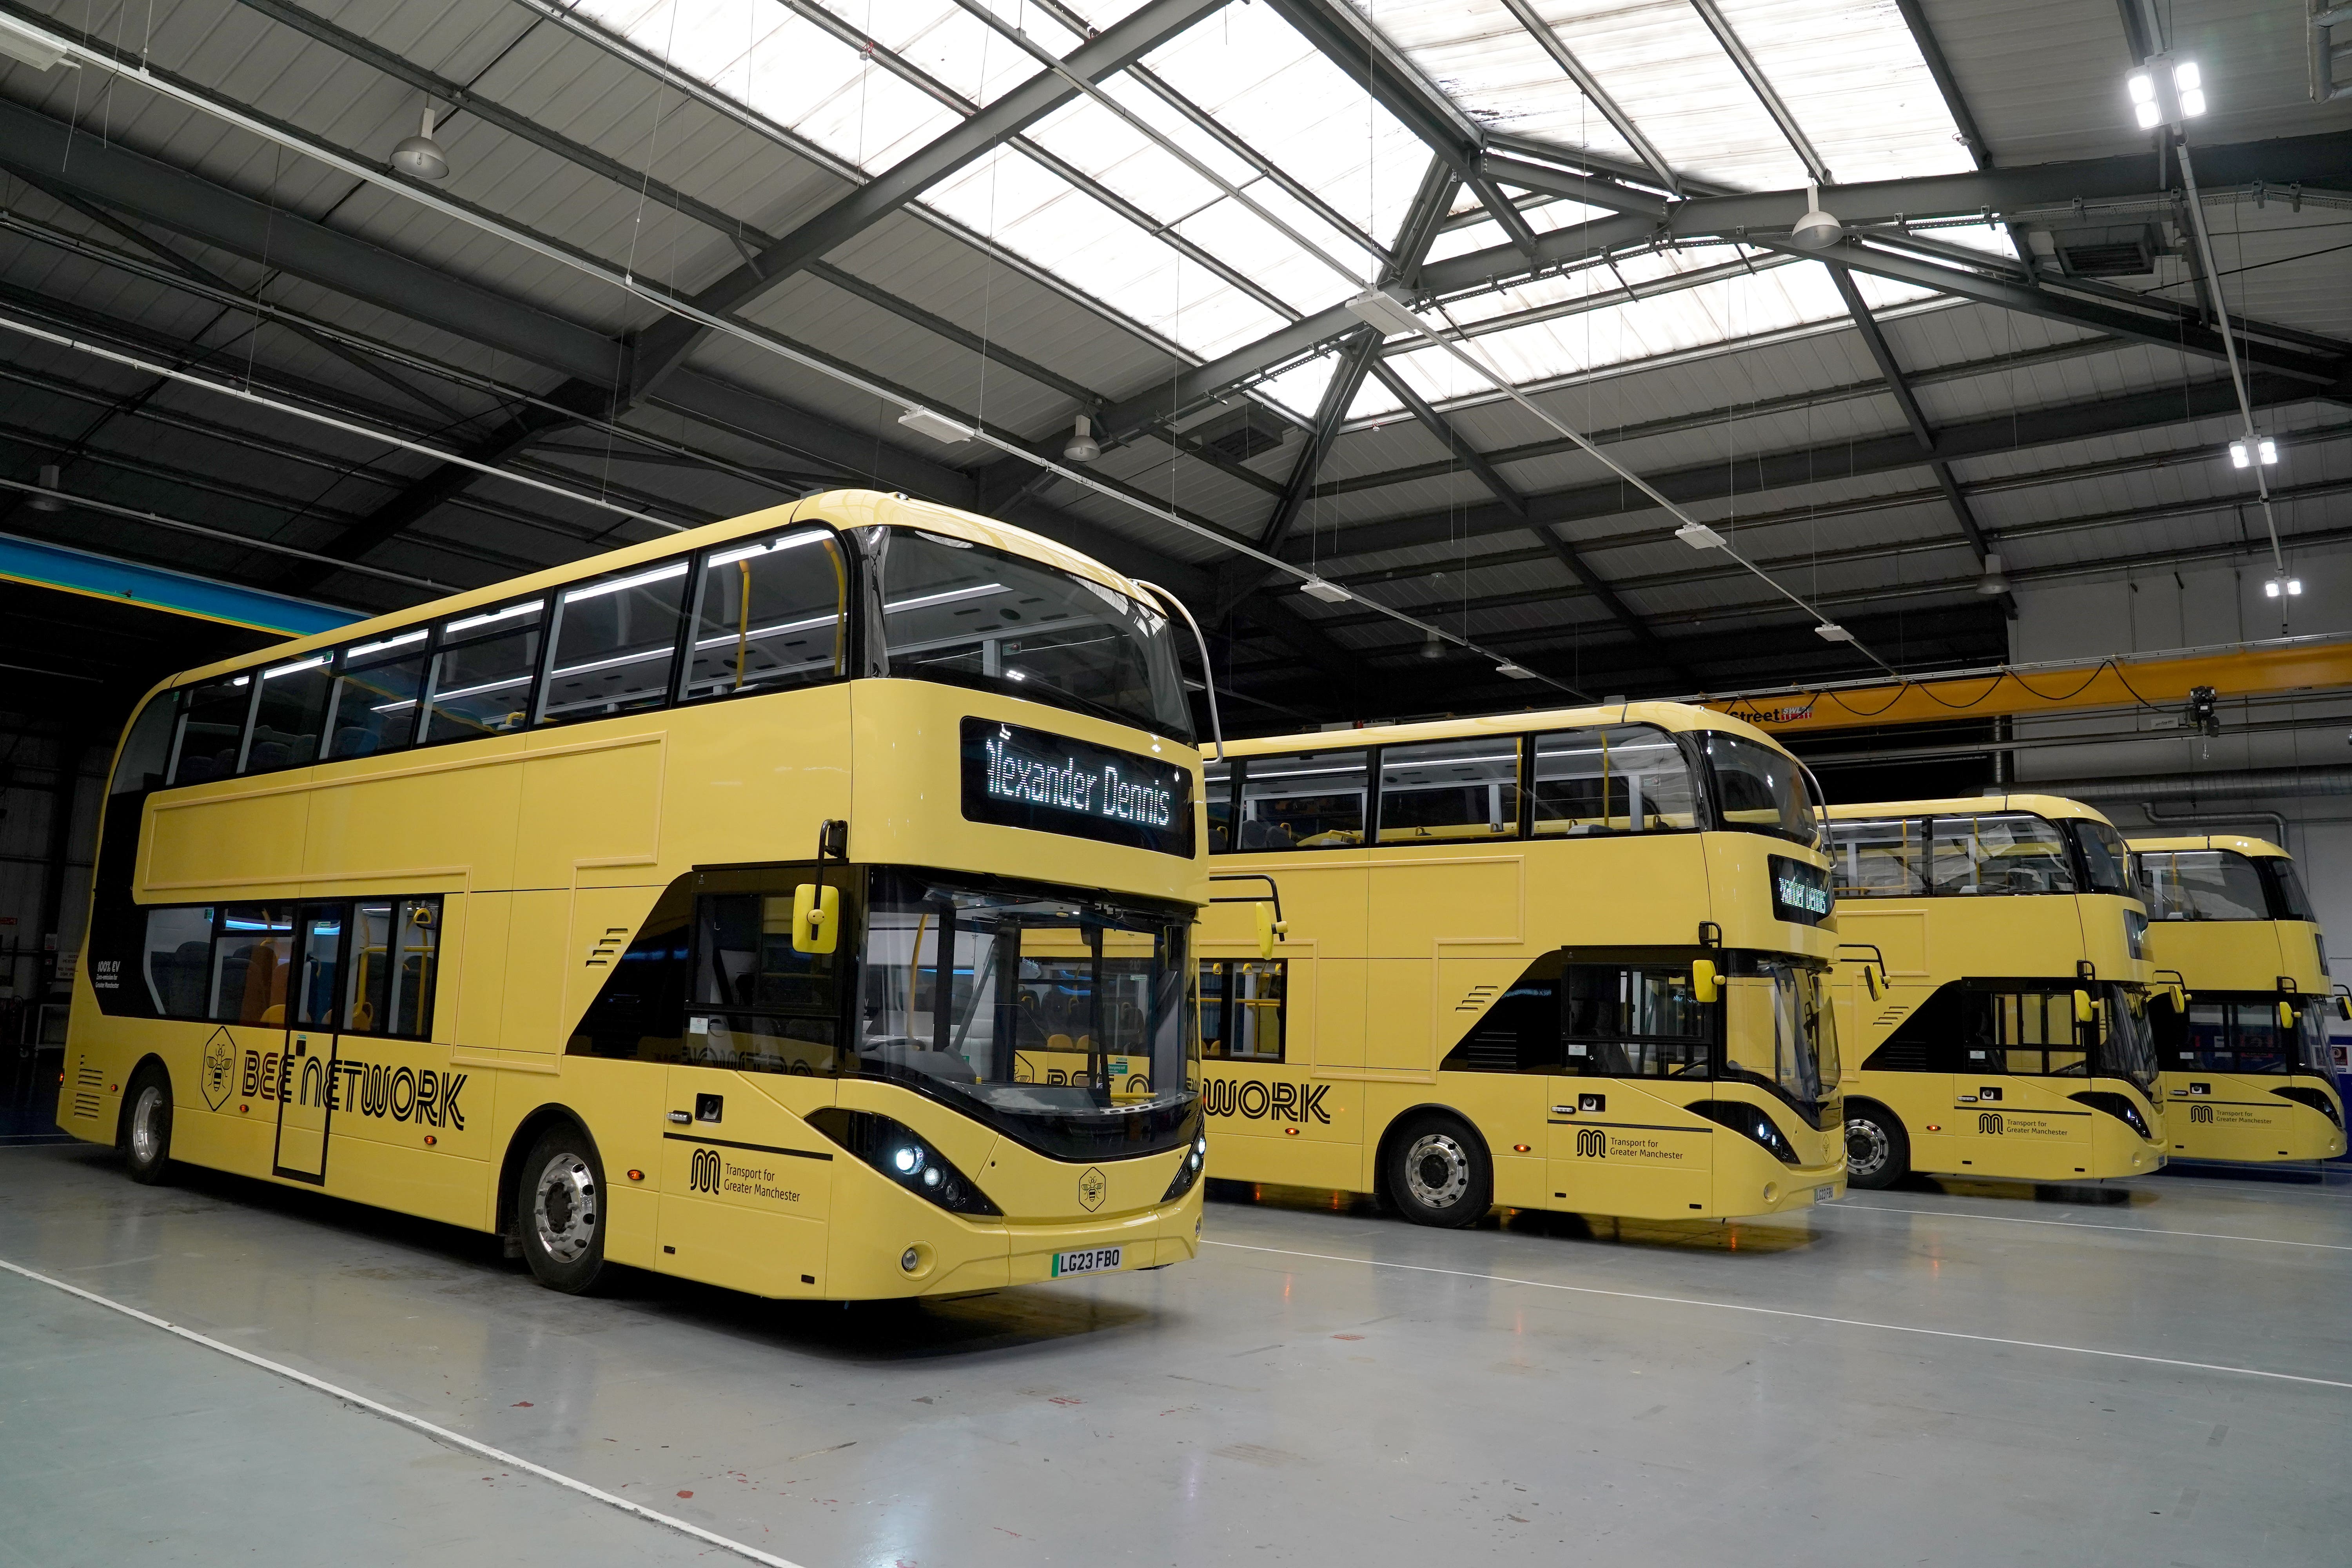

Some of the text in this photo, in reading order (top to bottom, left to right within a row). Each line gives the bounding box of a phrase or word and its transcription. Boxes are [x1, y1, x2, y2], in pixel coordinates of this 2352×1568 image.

[1730, 709, 1780, 723] Street
[1103, 766, 1170, 826] Dennis
[97, 961, 120, 972] 100% EV
[241, 1050, 468, 1131] BEE NETWORK
[1203, 1078, 1331, 1124] WORK
[1610, 1137, 1646, 1148] Transport
[1610, 1147, 1683, 1159] Greater Manchester
[726, 1163, 762, 1181] Transport
[764, 1169, 775, 1181] for
[724, 1179, 800, 1202] Greater Manchester
[1060, 1249, 1120, 1272] LG23 FBO
